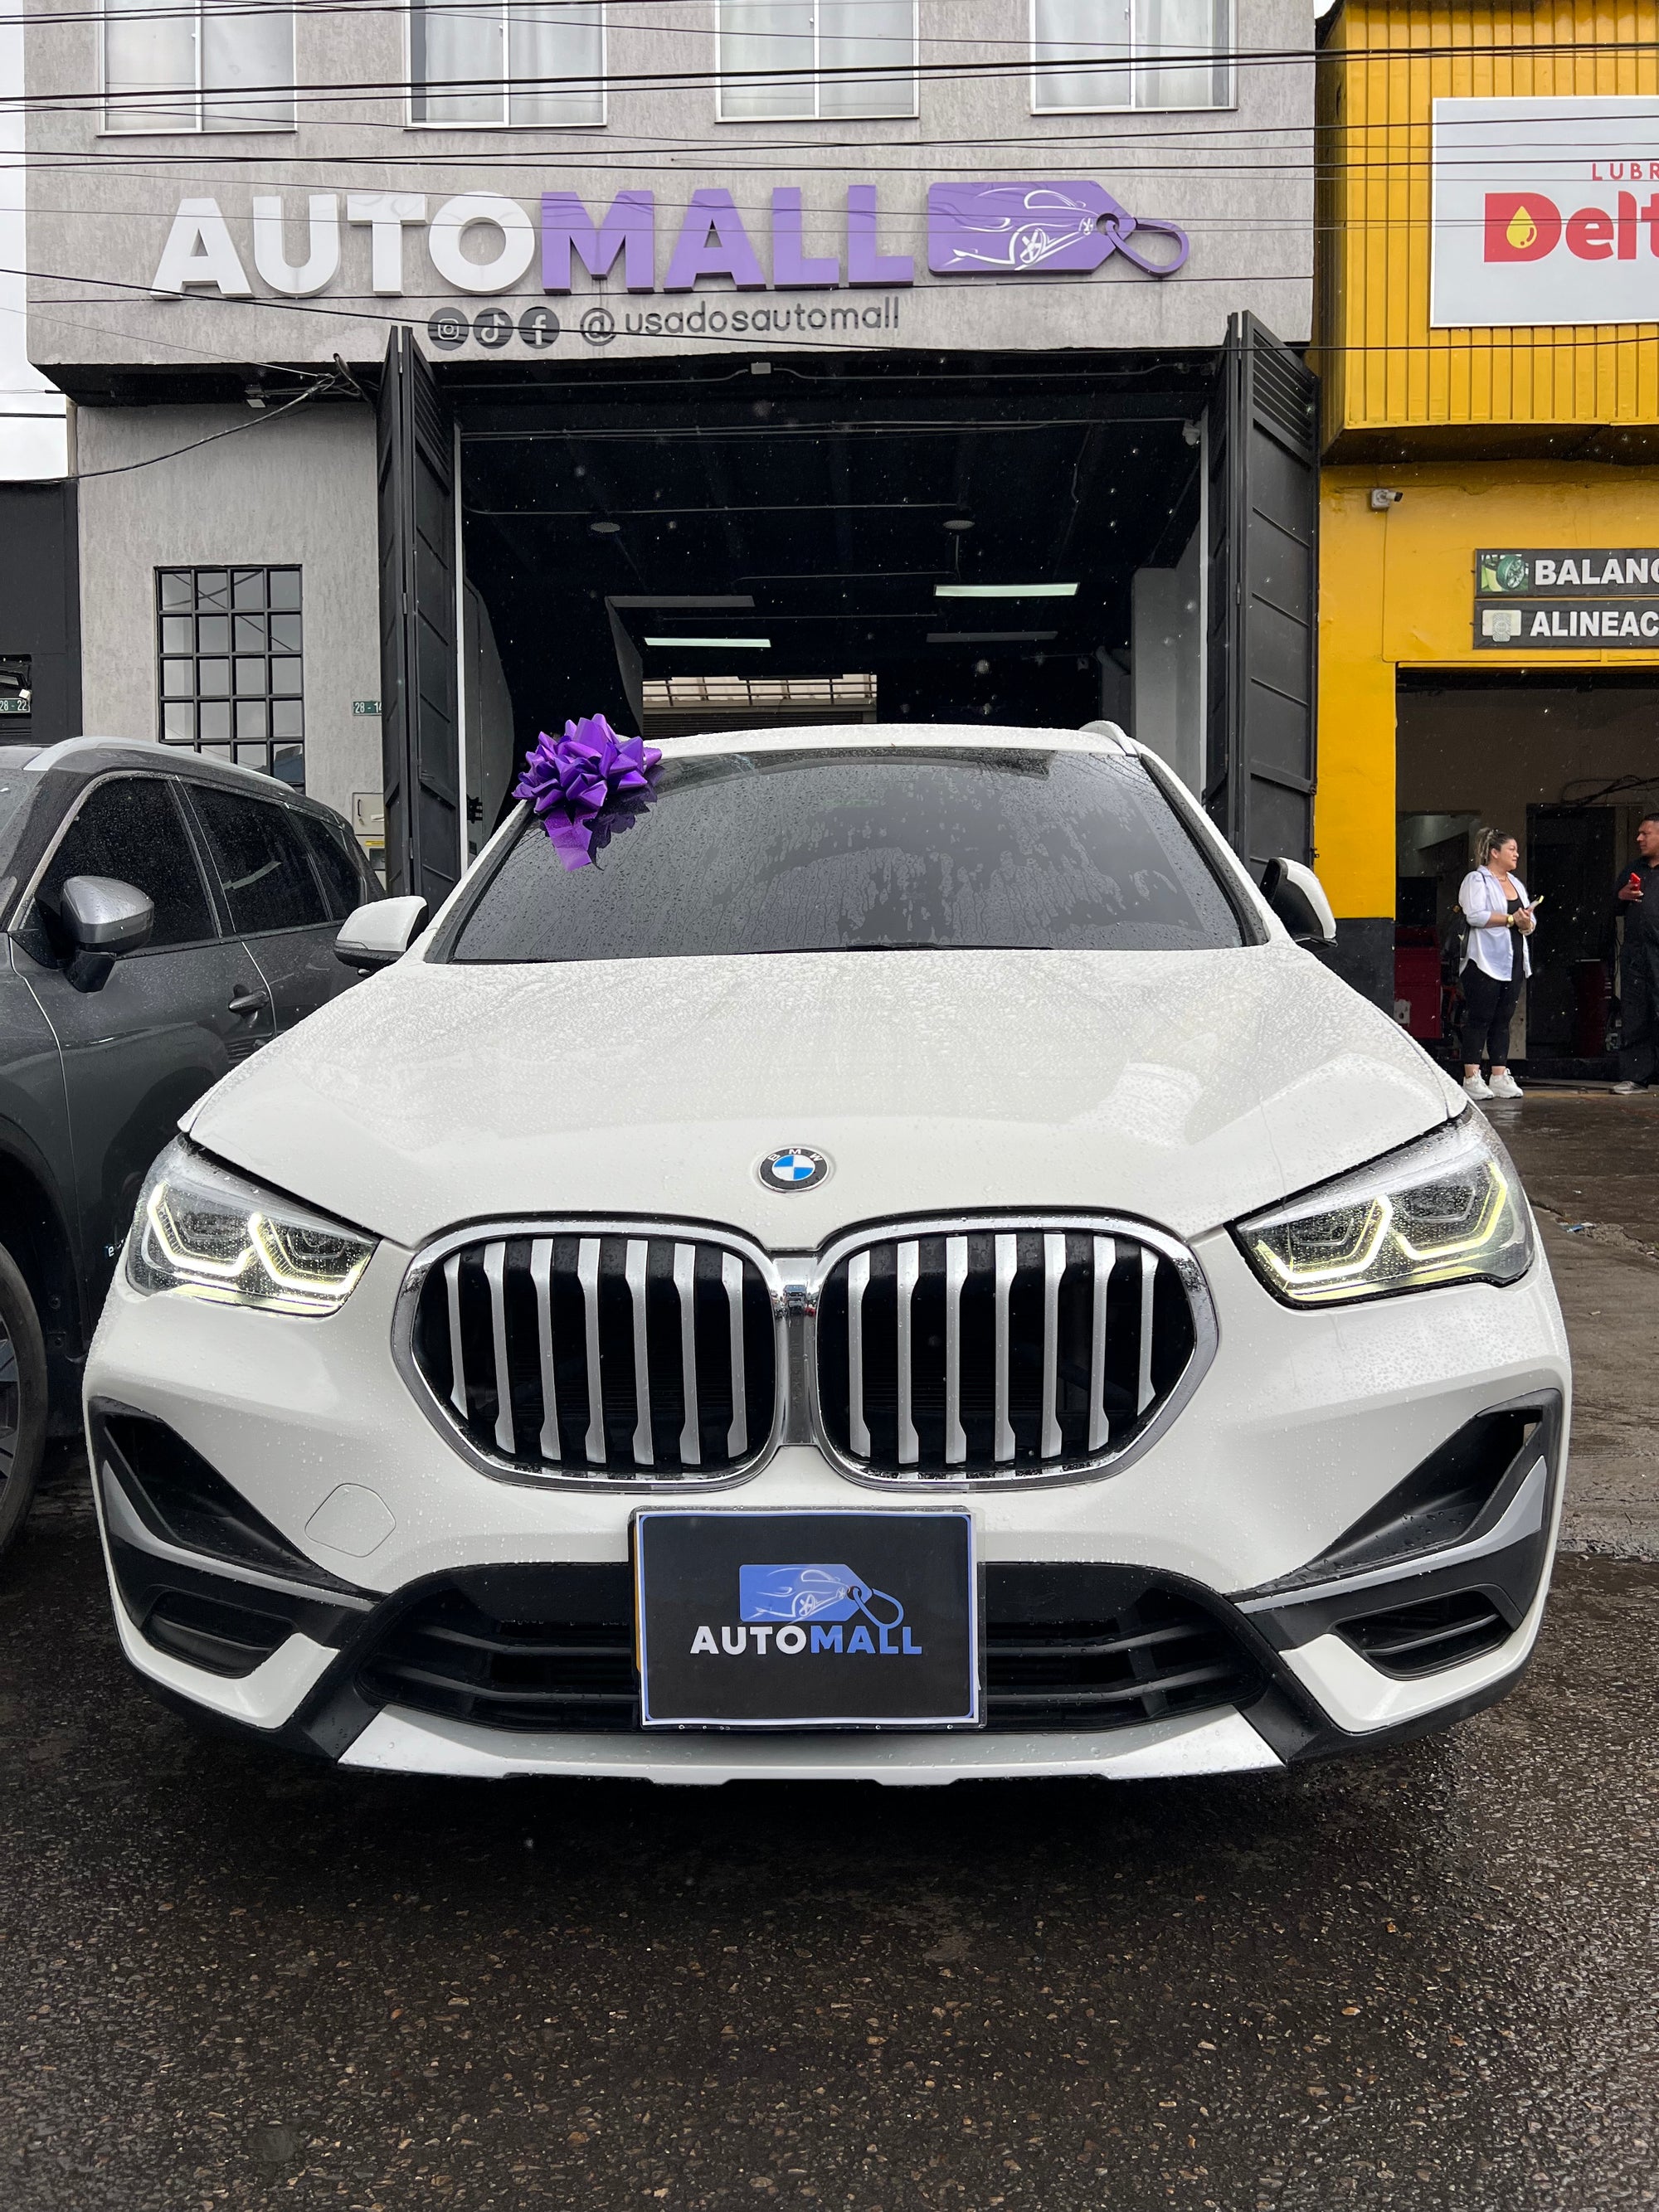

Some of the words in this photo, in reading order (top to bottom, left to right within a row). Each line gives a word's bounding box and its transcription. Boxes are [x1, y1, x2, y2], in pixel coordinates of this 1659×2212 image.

[149, 184, 914, 300] AUTOMALL
[1530, 610, 1659, 637] ALINEAC
[767, 1149, 823, 1162] BMW
[689, 1625, 922, 1655] AUTOMALL
